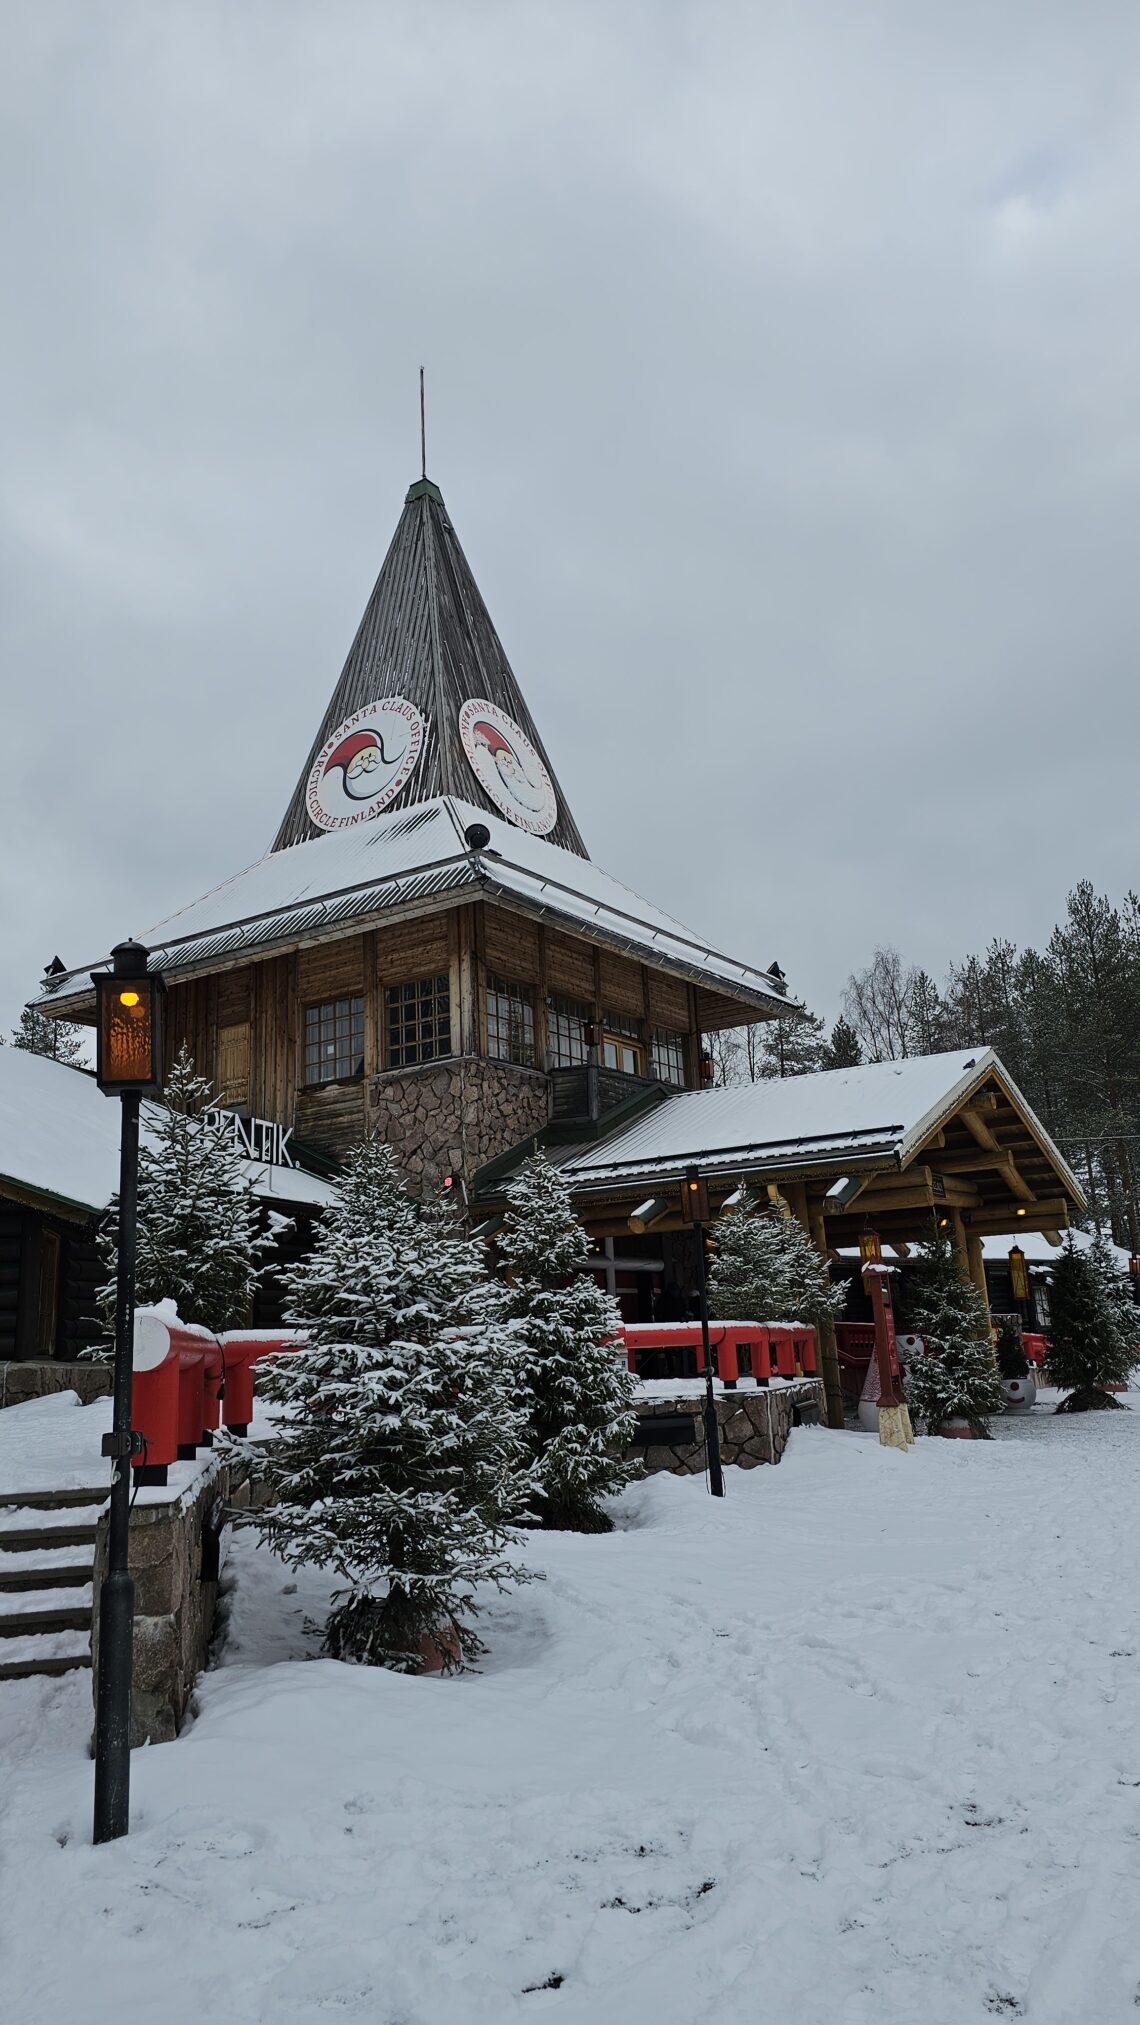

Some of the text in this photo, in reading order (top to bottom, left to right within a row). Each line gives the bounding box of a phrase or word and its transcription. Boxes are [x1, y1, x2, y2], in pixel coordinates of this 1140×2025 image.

[334, 701, 420, 776] SANTA CLAUS OFFICE
[467, 701, 499, 718] SANTA
[501, 714, 536, 757] CLAUS
[308, 749, 395, 828] ARCTIC CIRCLE FINLAND
